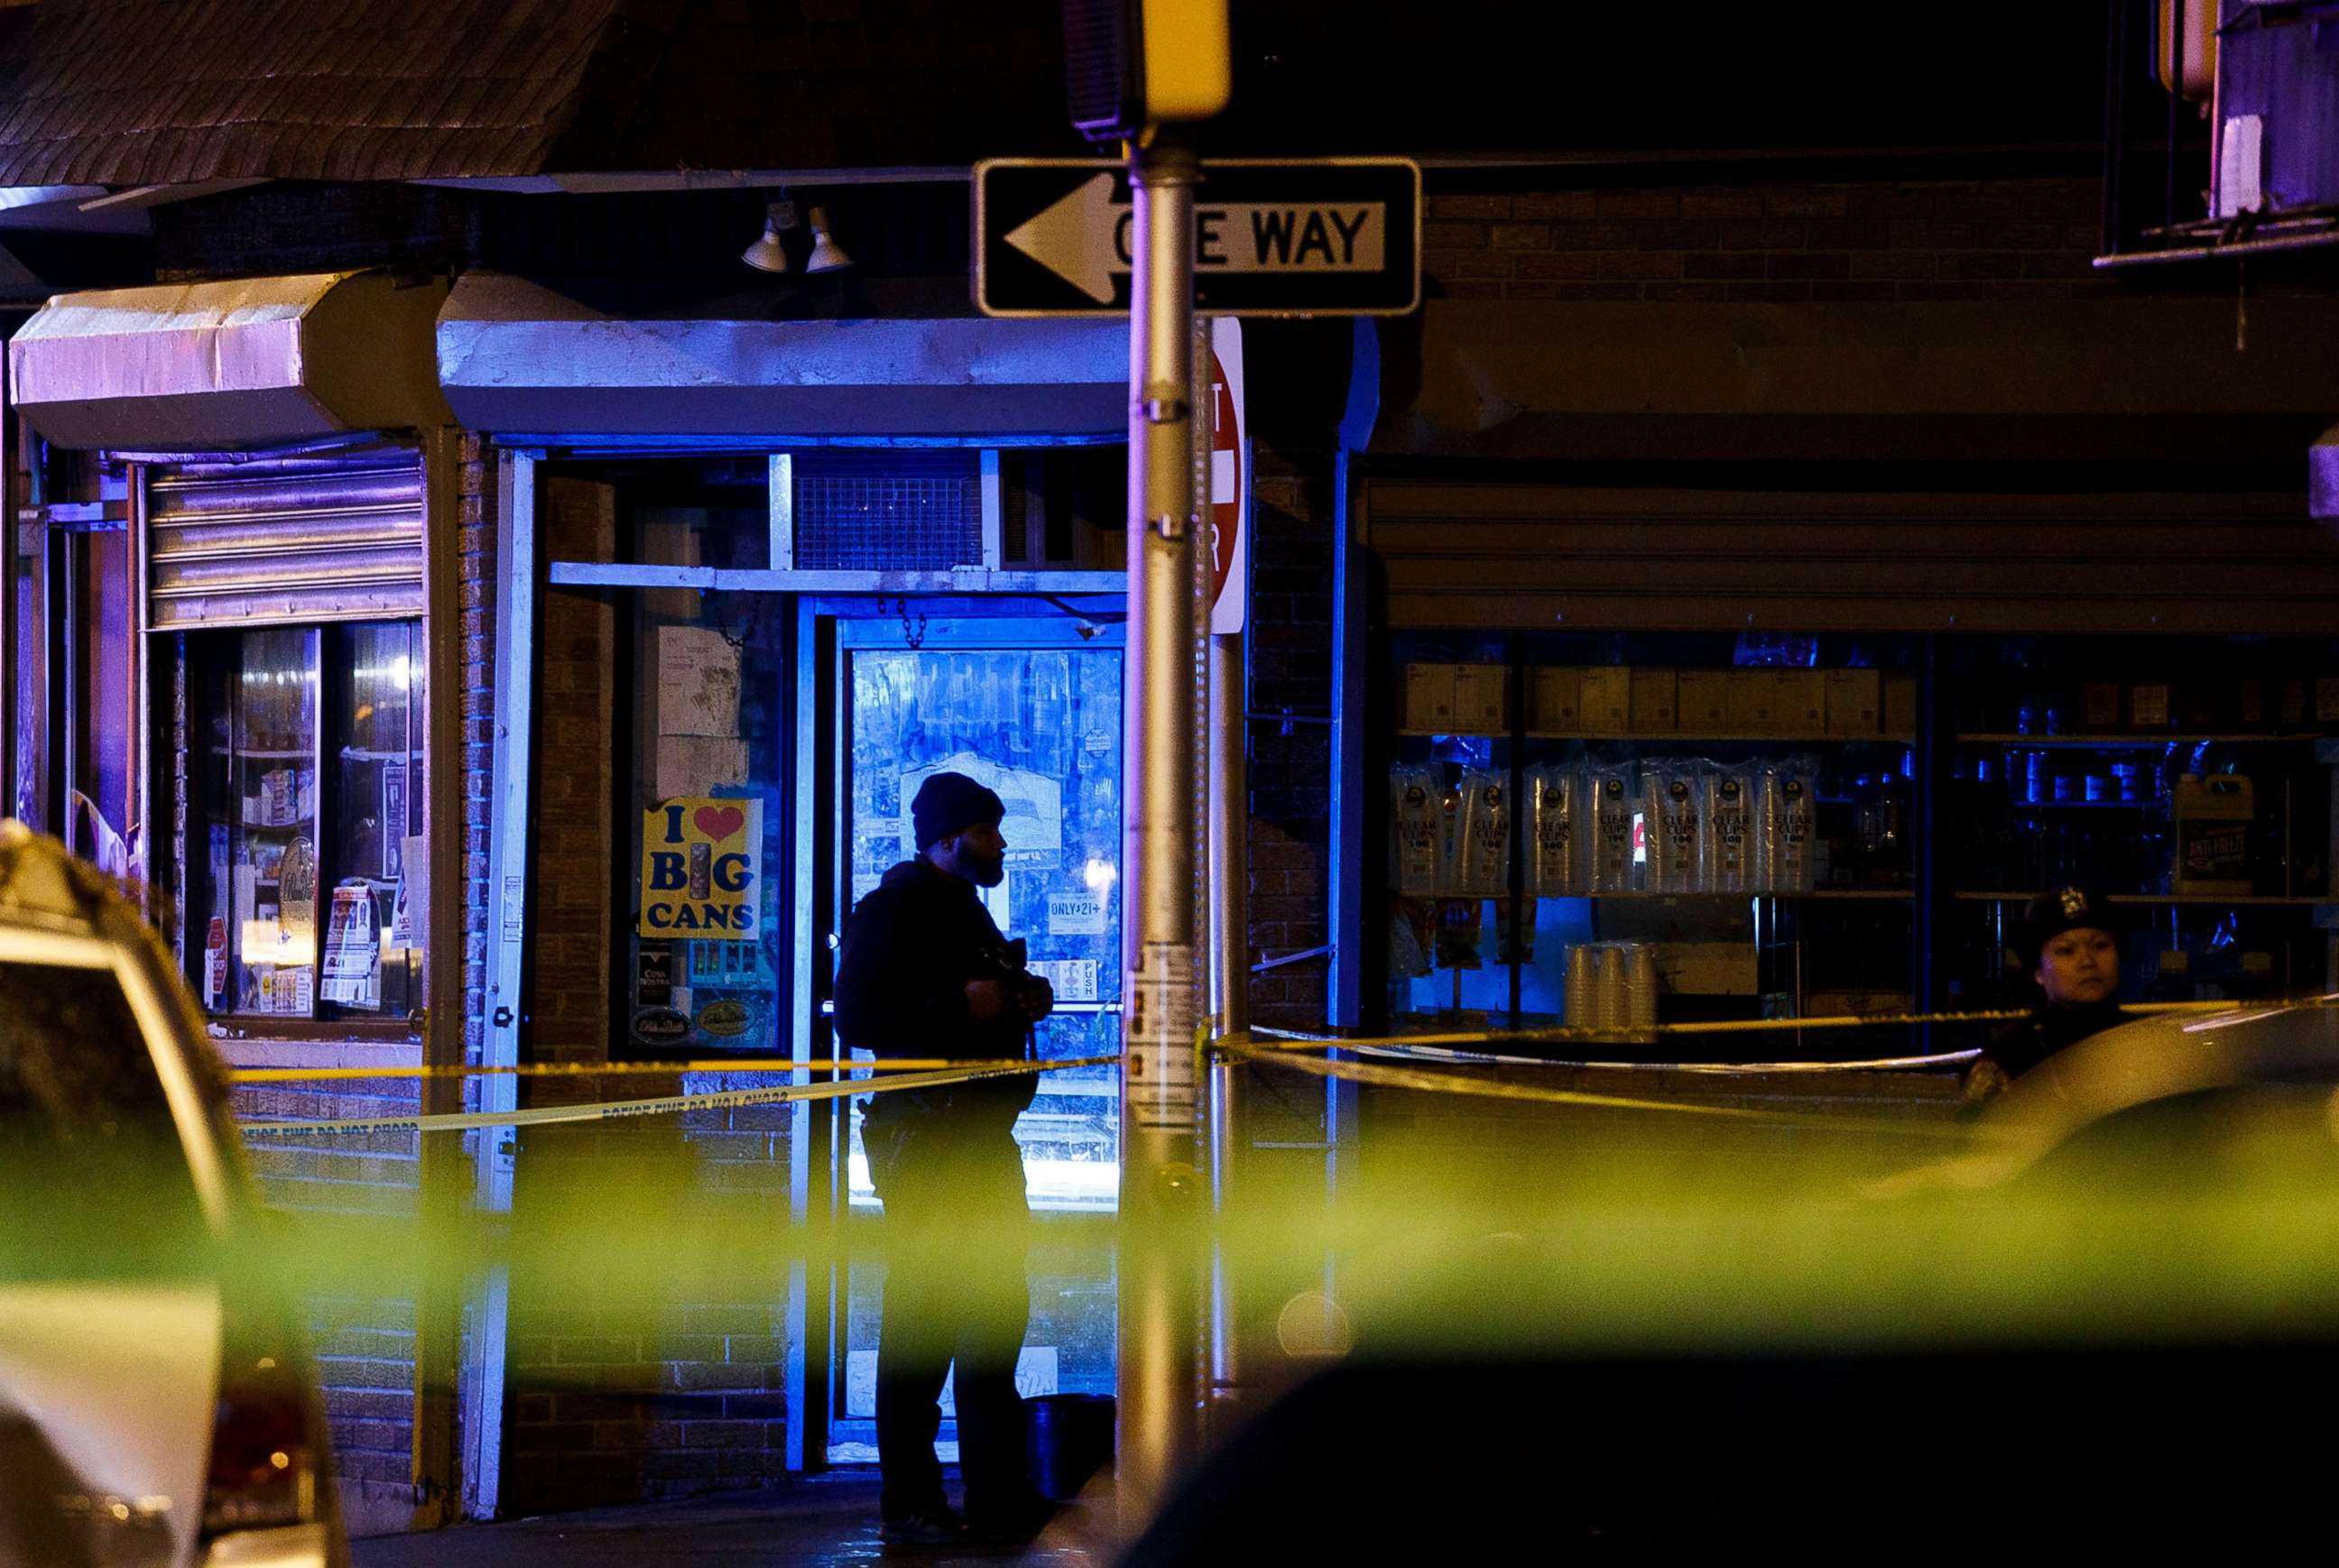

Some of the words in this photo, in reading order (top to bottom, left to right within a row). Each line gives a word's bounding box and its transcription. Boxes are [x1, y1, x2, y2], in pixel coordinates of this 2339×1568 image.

[1251, 210, 1369, 265] WAY
[664, 805, 686, 844] I
[1600, 815, 1632, 825] CLEAR
[1663, 815, 1699, 825] CLEAR
[1714, 815, 1750, 825] CLEAR
[1774, 815, 1813, 825] CLEAR
[1602, 824, 1629, 834] CUPS
[1666, 825, 1697, 835] CUPS
[1716, 825, 1747, 835] CUPS
[1778, 825, 1810, 835] CUPS
[1051, 901, 1076, 916] ONLY
[647, 902, 754, 930] CANS
